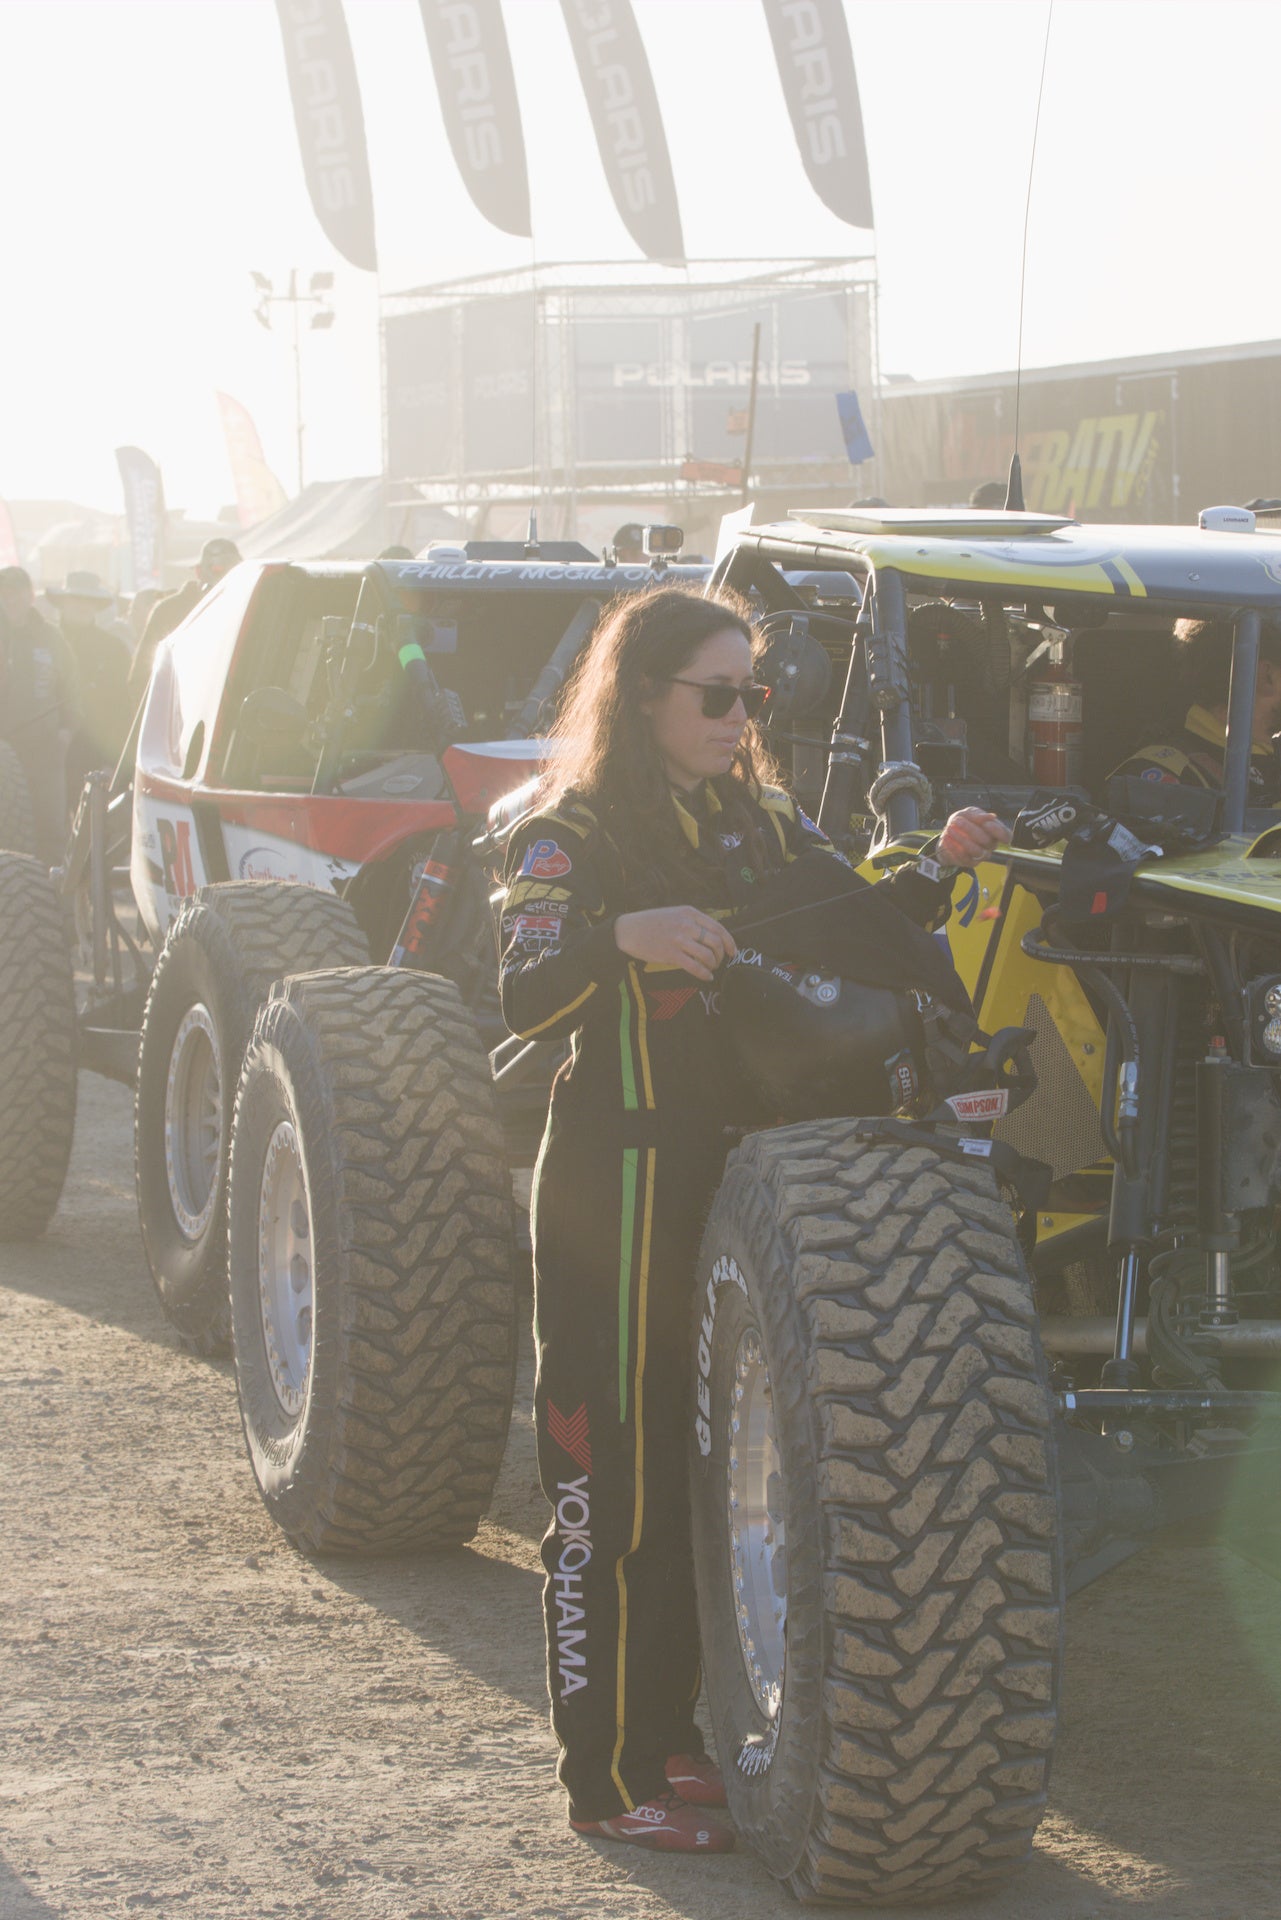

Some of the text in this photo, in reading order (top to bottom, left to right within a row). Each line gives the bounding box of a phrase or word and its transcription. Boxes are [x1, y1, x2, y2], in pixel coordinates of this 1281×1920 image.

[612, 360, 812, 388] POLARIS
[396, 564, 513, 580] PHILLIP
[957, 1097, 999, 1114] SIMPSON
[552, 1472, 594, 1698] YOKOHAMA
